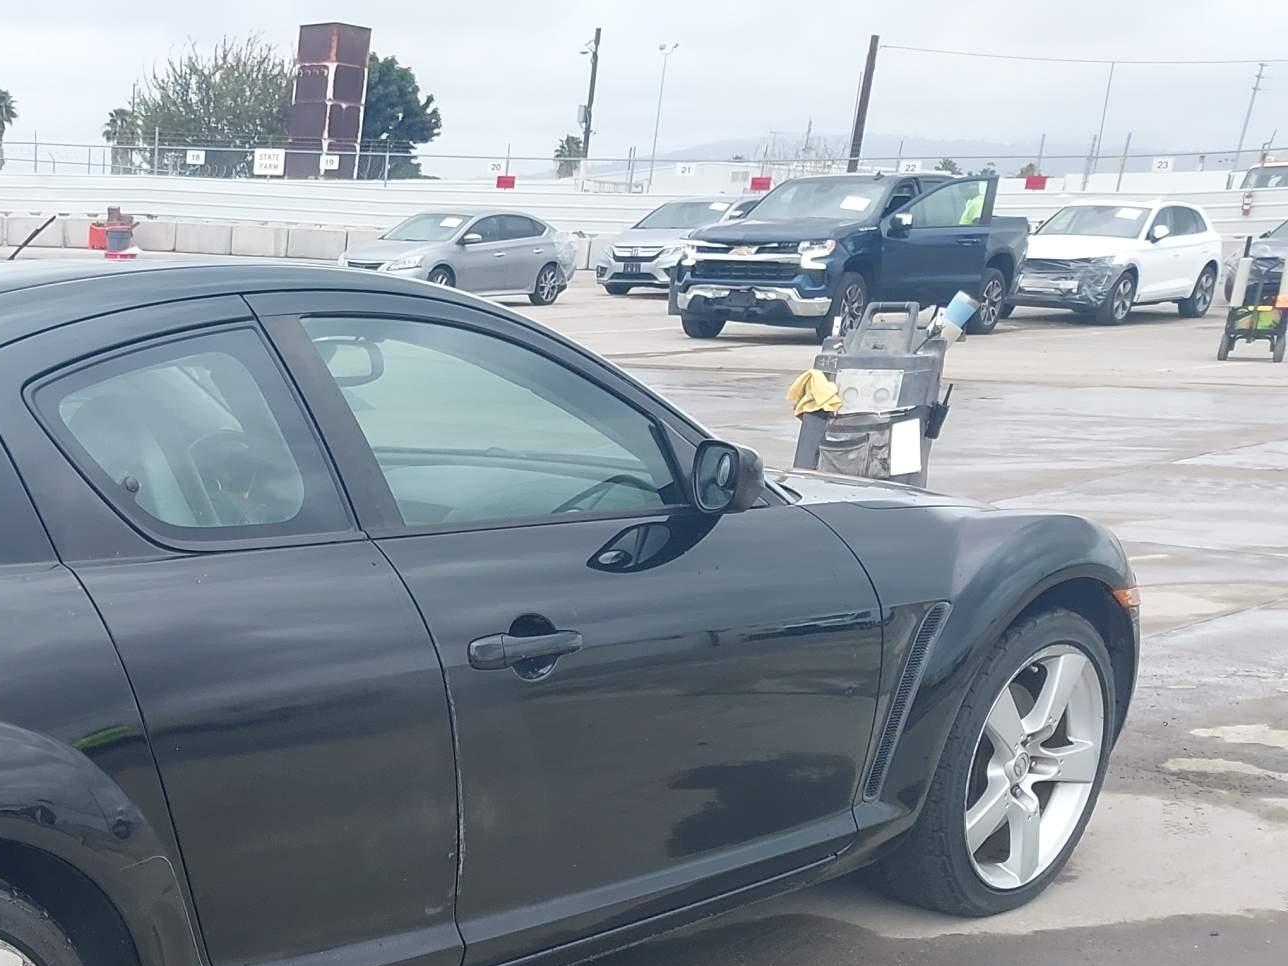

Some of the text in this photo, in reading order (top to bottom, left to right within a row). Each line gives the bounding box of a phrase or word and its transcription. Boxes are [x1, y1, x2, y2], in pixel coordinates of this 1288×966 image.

[191, 153, 201, 162] 18
[258, 153, 281, 161] STATE
[258, 162, 280, 170] FARM
[325, 158, 335, 167] 19
[1156, 160, 1169, 169] 23
[490, 163, 502, 172] 20
[681, 166, 692, 174] 21
[904, 164, 917, 172] 22
